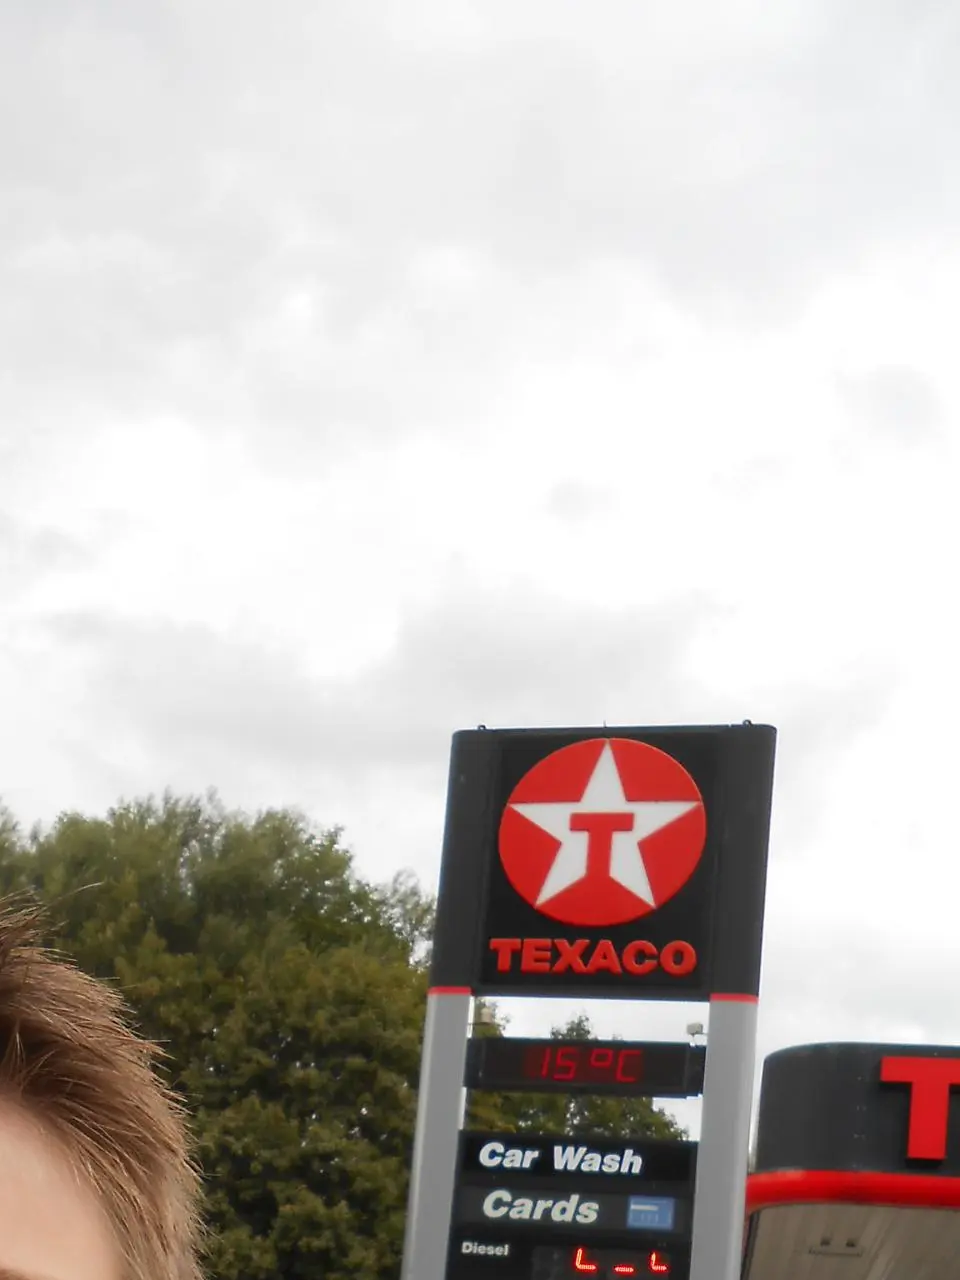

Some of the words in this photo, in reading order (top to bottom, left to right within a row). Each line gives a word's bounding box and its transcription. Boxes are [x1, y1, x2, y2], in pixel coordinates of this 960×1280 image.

[570, 812, 634, 877] T
[489, 938, 698, 977] TEXACO
[479, 1142, 539, 1169] Car
[553, 1145, 643, 1174] Wash
[482, 1189, 599, 1224] Cards
[461, 1241, 511, 1257] Diesel
